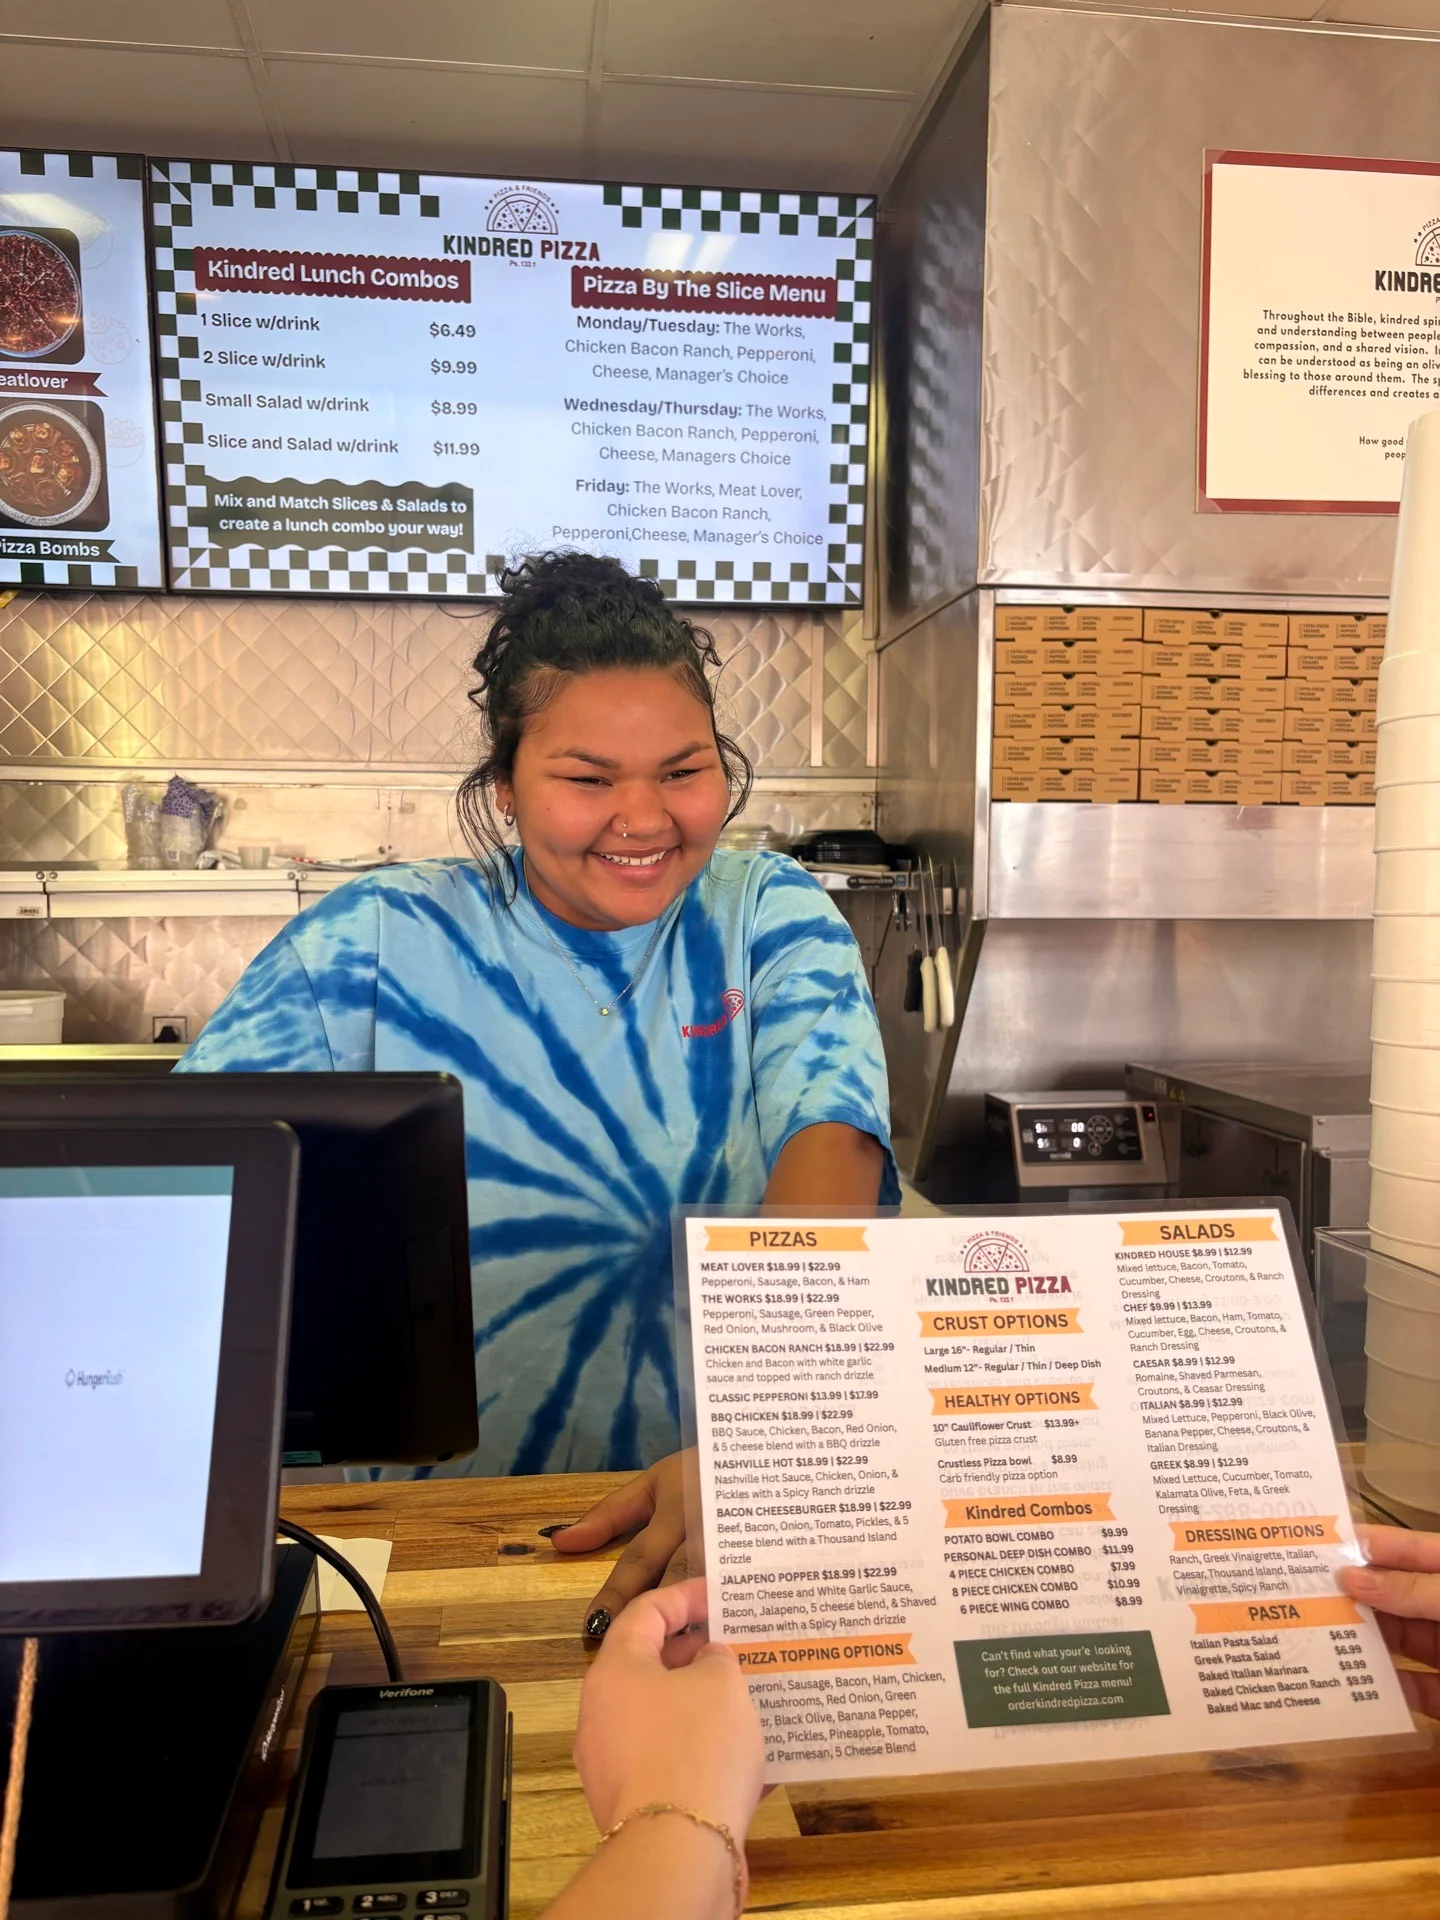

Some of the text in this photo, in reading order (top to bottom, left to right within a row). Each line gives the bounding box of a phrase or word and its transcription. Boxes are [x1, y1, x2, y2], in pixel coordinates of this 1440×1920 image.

[443, 234, 601, 262] KINDRED PIZZA
[208, 259, 460, 290] Kindred Lunch Combos
[1375, 270, 1440, 294] KINDRE
[584, 274, 826, 303] Pizza By The Slice Menu
[200, 312, 476, 339] 1 Slice w/drink $6.49
[1262, 309, 1325, 324] Throughout
[1327, 311, 1344, 323] the
[1347, 312, 1377, 325] Bible,
[1380, 313, 1420, 326] kindred
[577, 315, 806, 340] Monday/Tuesday: The Works,
[1257, 324, 1277, 335] and
[1280, 325, 1357, 341] understanding
[1360, 327, 1405, 340] between
[565, 339, 816, 364] Chicken Bacon Ranch, Pepperoni,
[203, 350, 477, 375] 2 Slice w/drink $9.99
[1258, 357, 1277, 365] can
[1280, 354, 1293, 366] be
[1296, 355, 1356, 367] understood
[1359, 360, 1371, 368] as
[1374, 357, 1403, 372] being
[1422, 359, 1440, 370] oliv
[0, 372, 69, 389] eatlover
[592, 364, 652, 382] Cheese,
[737, 369, 789, 385] Choice
[1308, 385, 1367, 397] differences
[1369, 387, 1390, 398] and
[1392, 389, 1430, 399] creates
[205, 392, 478, 417] Small Salad w/drink $8.99
[563, 397, 827, 422] Wednesday/Thursday: The Works,
[207, 433, 480, 457] Slice and Salad w/drink $11.99
[1359, 436, 1404, 448] How good
[1384, 452, 1407, 461] peop
[575, 478, 803, 501] Friday: The Works, Meat Lover,
[214, 493, 468, 514] Mix and Match Slices & Salads to
[219, 517, 464, 538] create a lunch combo your way!
[0, 538, 100, 557] izza Bombs
[749, 1231, 818, 1247] PIZZAS
[1159, 1223, 1235, 1241] SALADS
[701, 1276, 870, 1288] Pepperoni, Sausage, Bacon, & Ham
[925, 1275, 1072, 1297] KINDRED PIZZA
[933, 1313, 1069, 1331] CRUST OPTIONS
[1135, 1369, 1262, 1383] Romaine, Shaved Parmesan,
[944, 1391, 1081, 1409] HEALTHY OPTIONS
[950, 1421, 1005, 1432] Cauliflower
[1006, 1420, 1032, 1430] Crust
[934, 1435, 1038, 1447] Gluten free pizza crust
[965, 1501, 1093, 1520] Kindred Combos
[944, 1527, 1129, 1545] POTATO BOWL COMBO $9.99
[1185, 1524, 1325, 1543] DRESSING OPTIONS
[943, 1544, 1134, 1563] PERSONAL DEEP DISH COMBO $11.99
[1248, 1604, 1301, 1622] PASTA
[1190, 1629, 1357, 1650] Italian Pasta Salad $6.99
[738, 1643, 904, 1666] PIZZA TOPPING OPTIONS
[1010, 1648, 1032, 1660] find
[1032, 1648, 1059, 1659] what
[1094, 1643, 1132, 1656] looking
[1198, 1659, 1367, 1682] Baked Italian Marinara $9.99
[379, 1688, 434, 1698] Verifone
[1007, 1695, 1124, 1711] orderkindredpizza.com
[303, 1898, 312, 1912] 1
[360, 1895, 374, 1908] 2
[424, 1891, 438, 1904] 3
